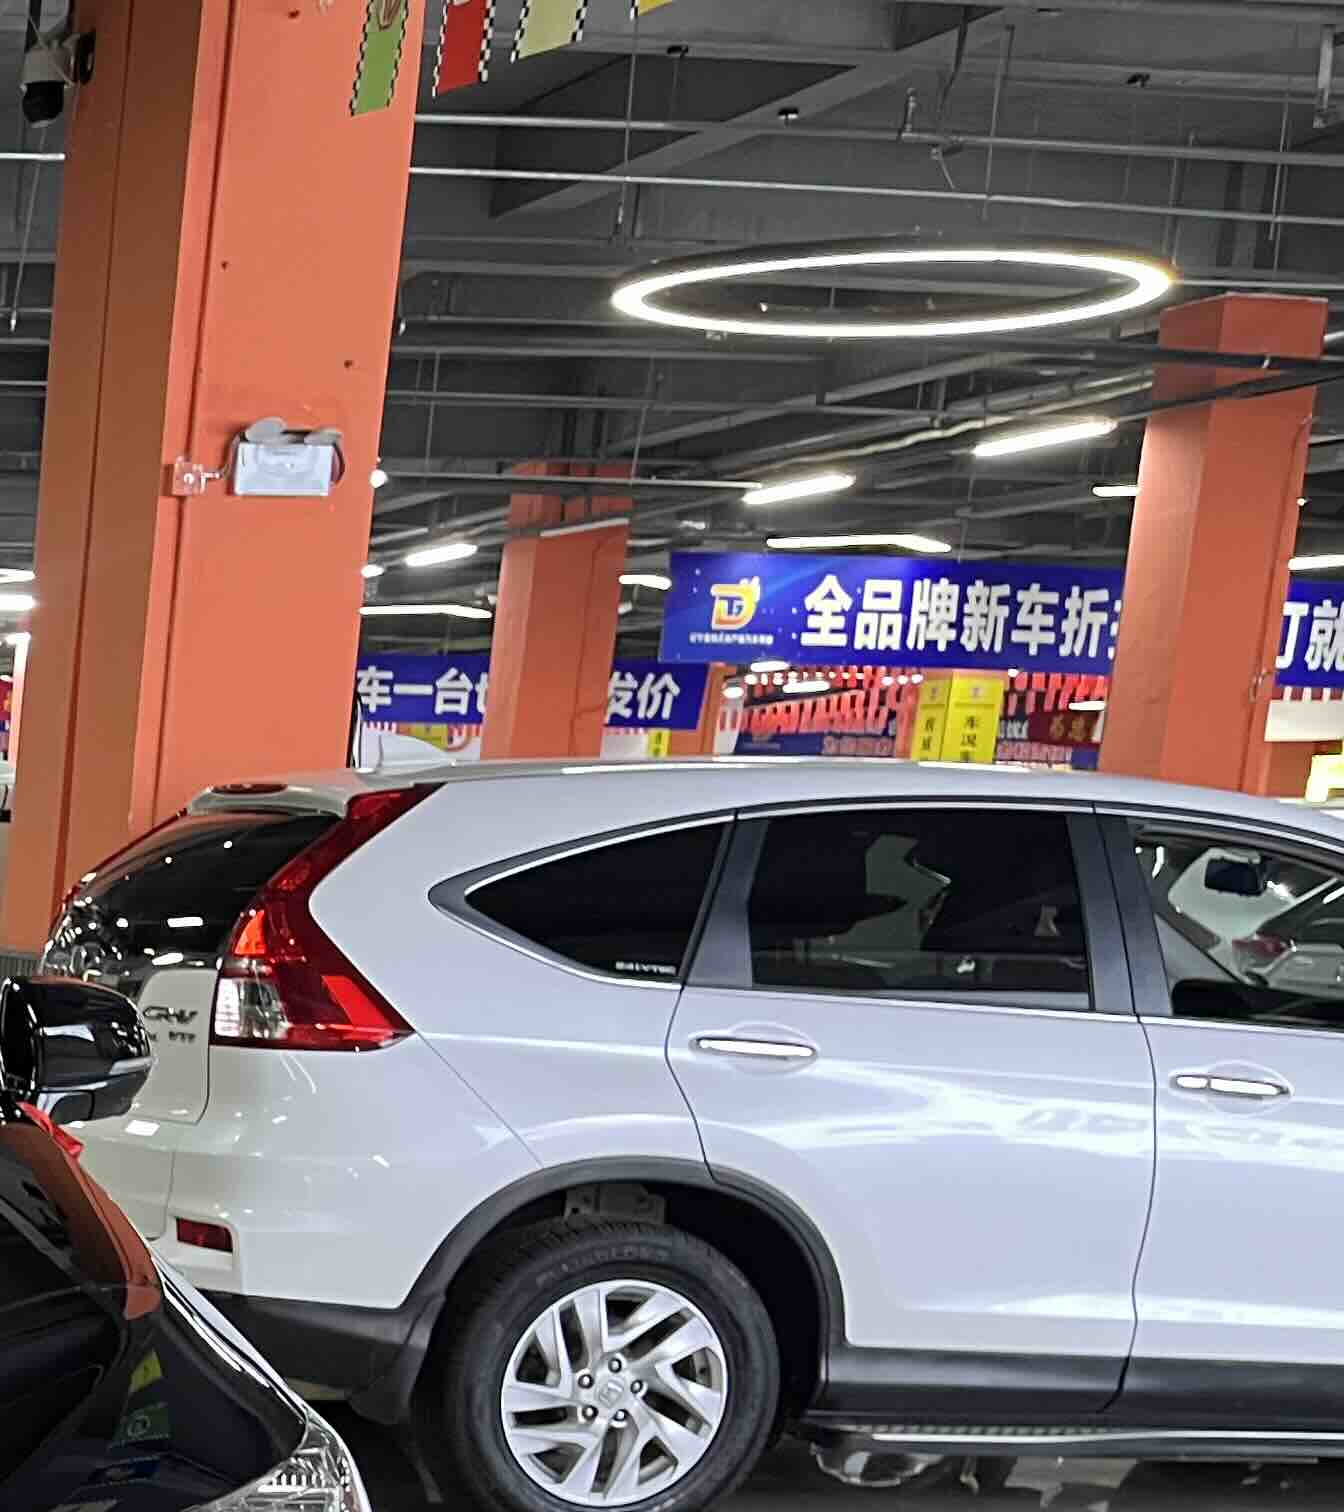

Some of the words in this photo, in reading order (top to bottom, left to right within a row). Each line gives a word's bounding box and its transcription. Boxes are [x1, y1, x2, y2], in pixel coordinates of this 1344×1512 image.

[799, 573, 1122, 660] 全品牌新车折
